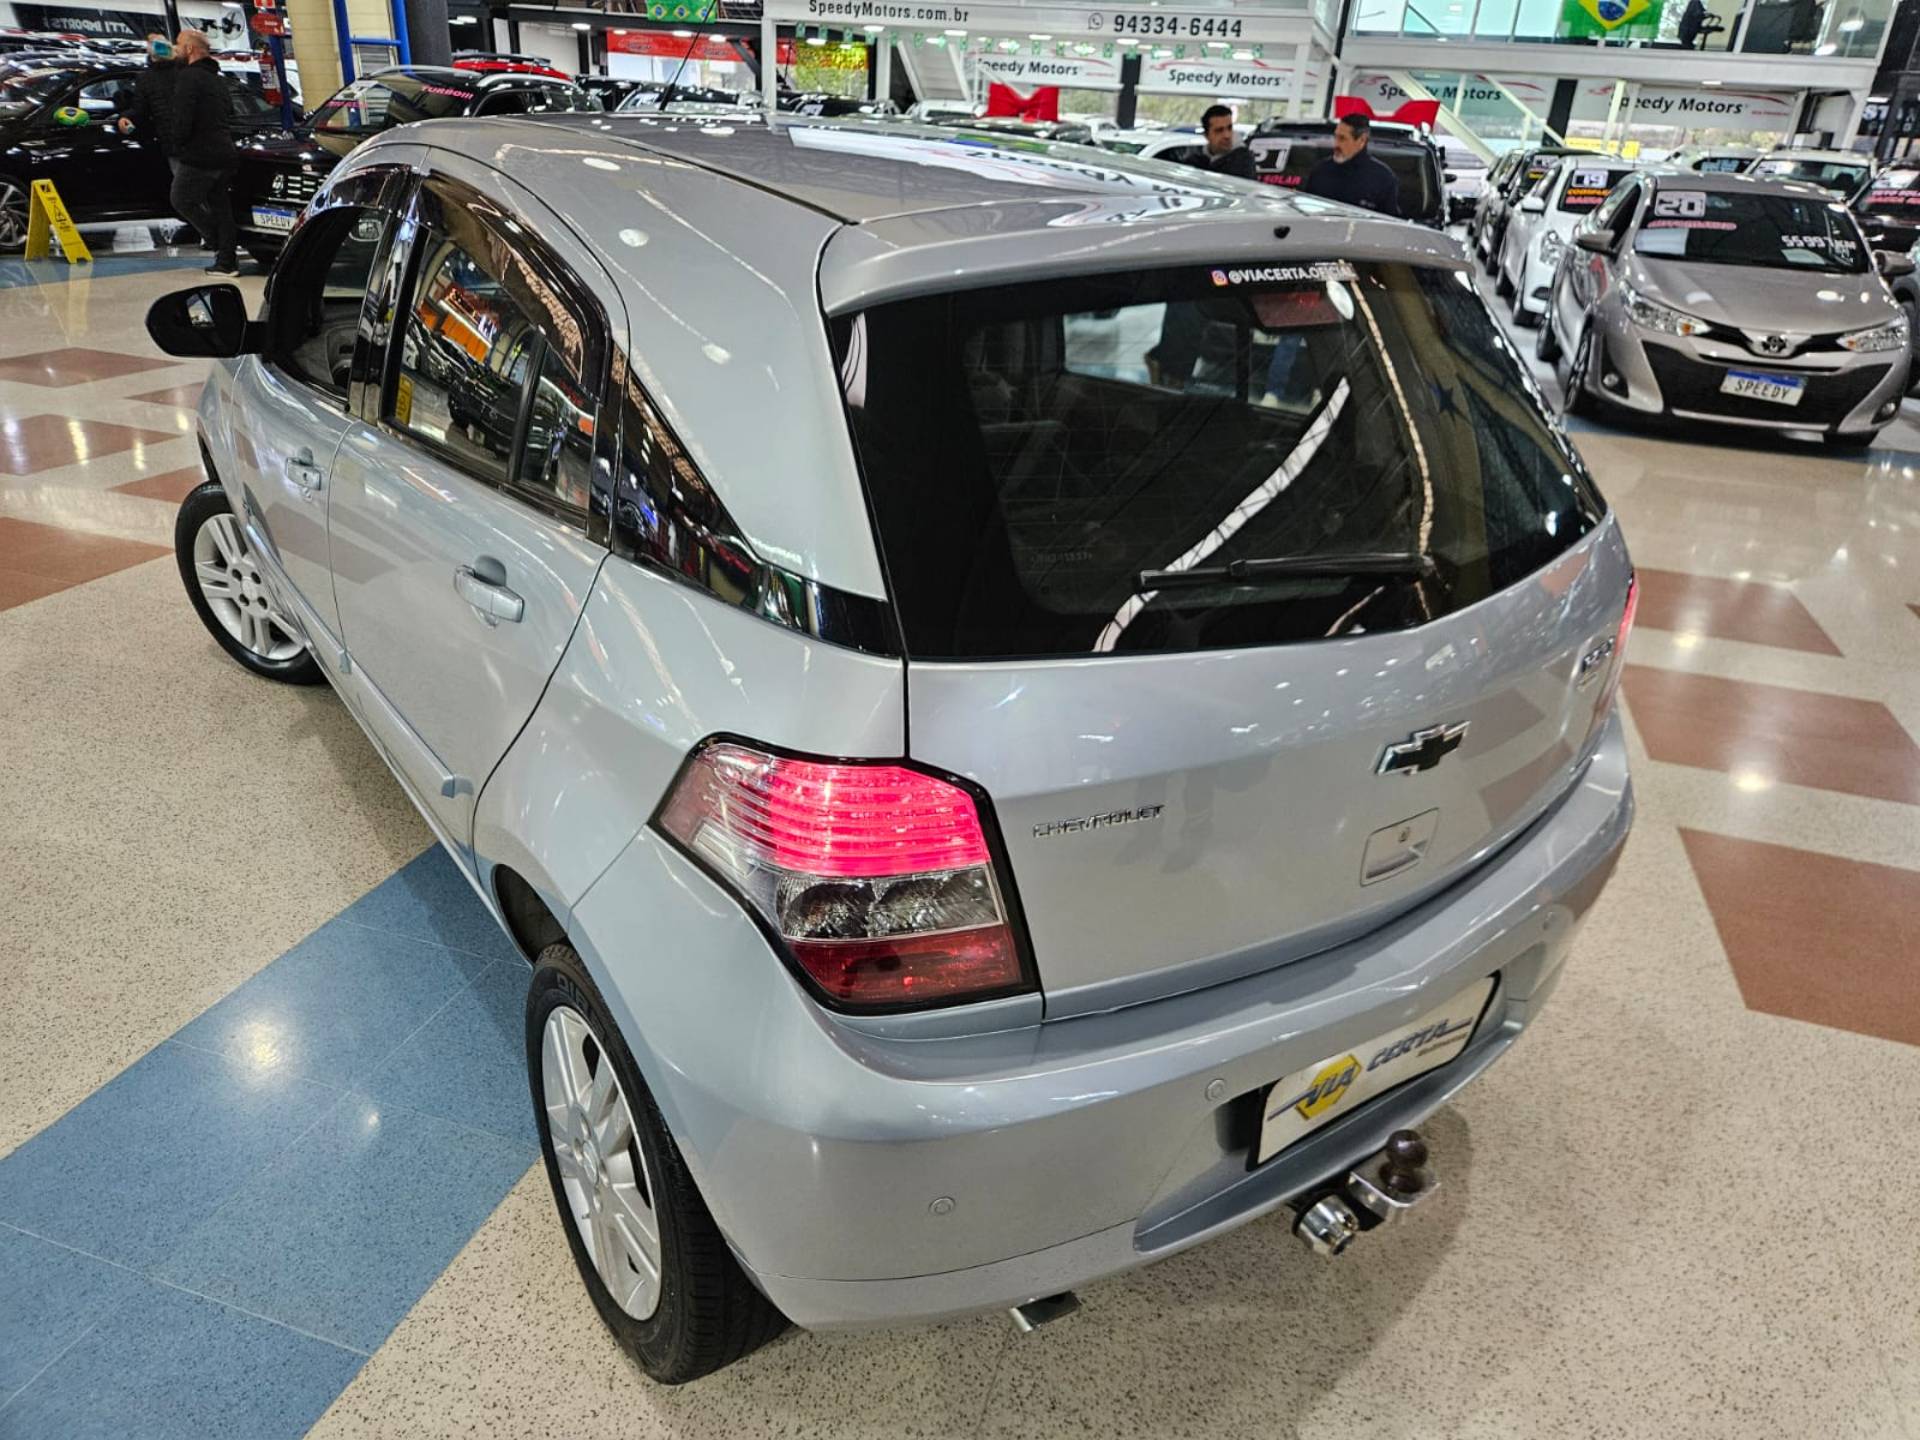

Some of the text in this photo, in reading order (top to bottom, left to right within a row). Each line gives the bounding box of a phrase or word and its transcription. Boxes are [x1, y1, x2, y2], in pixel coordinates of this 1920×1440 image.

[808, 0, 969, 22] SpeedyMotors.com.br
[1113, 14, 1242, 38] 94334-6444
[1028, 61, 1079, 76] Motors
[1168, 69, 1281, 87] Speedy Motors
[1379, 83, 1439, 100] Spey
[1678, 97, 1744, 114] Motors
[1655, 192, 1706, 217] 20
[1733, 378, 1791, 400] SPEEDY
[1303, 1063, 1357, 1109] VIA
[1366, 1018, 1451, 1073] CERTA
